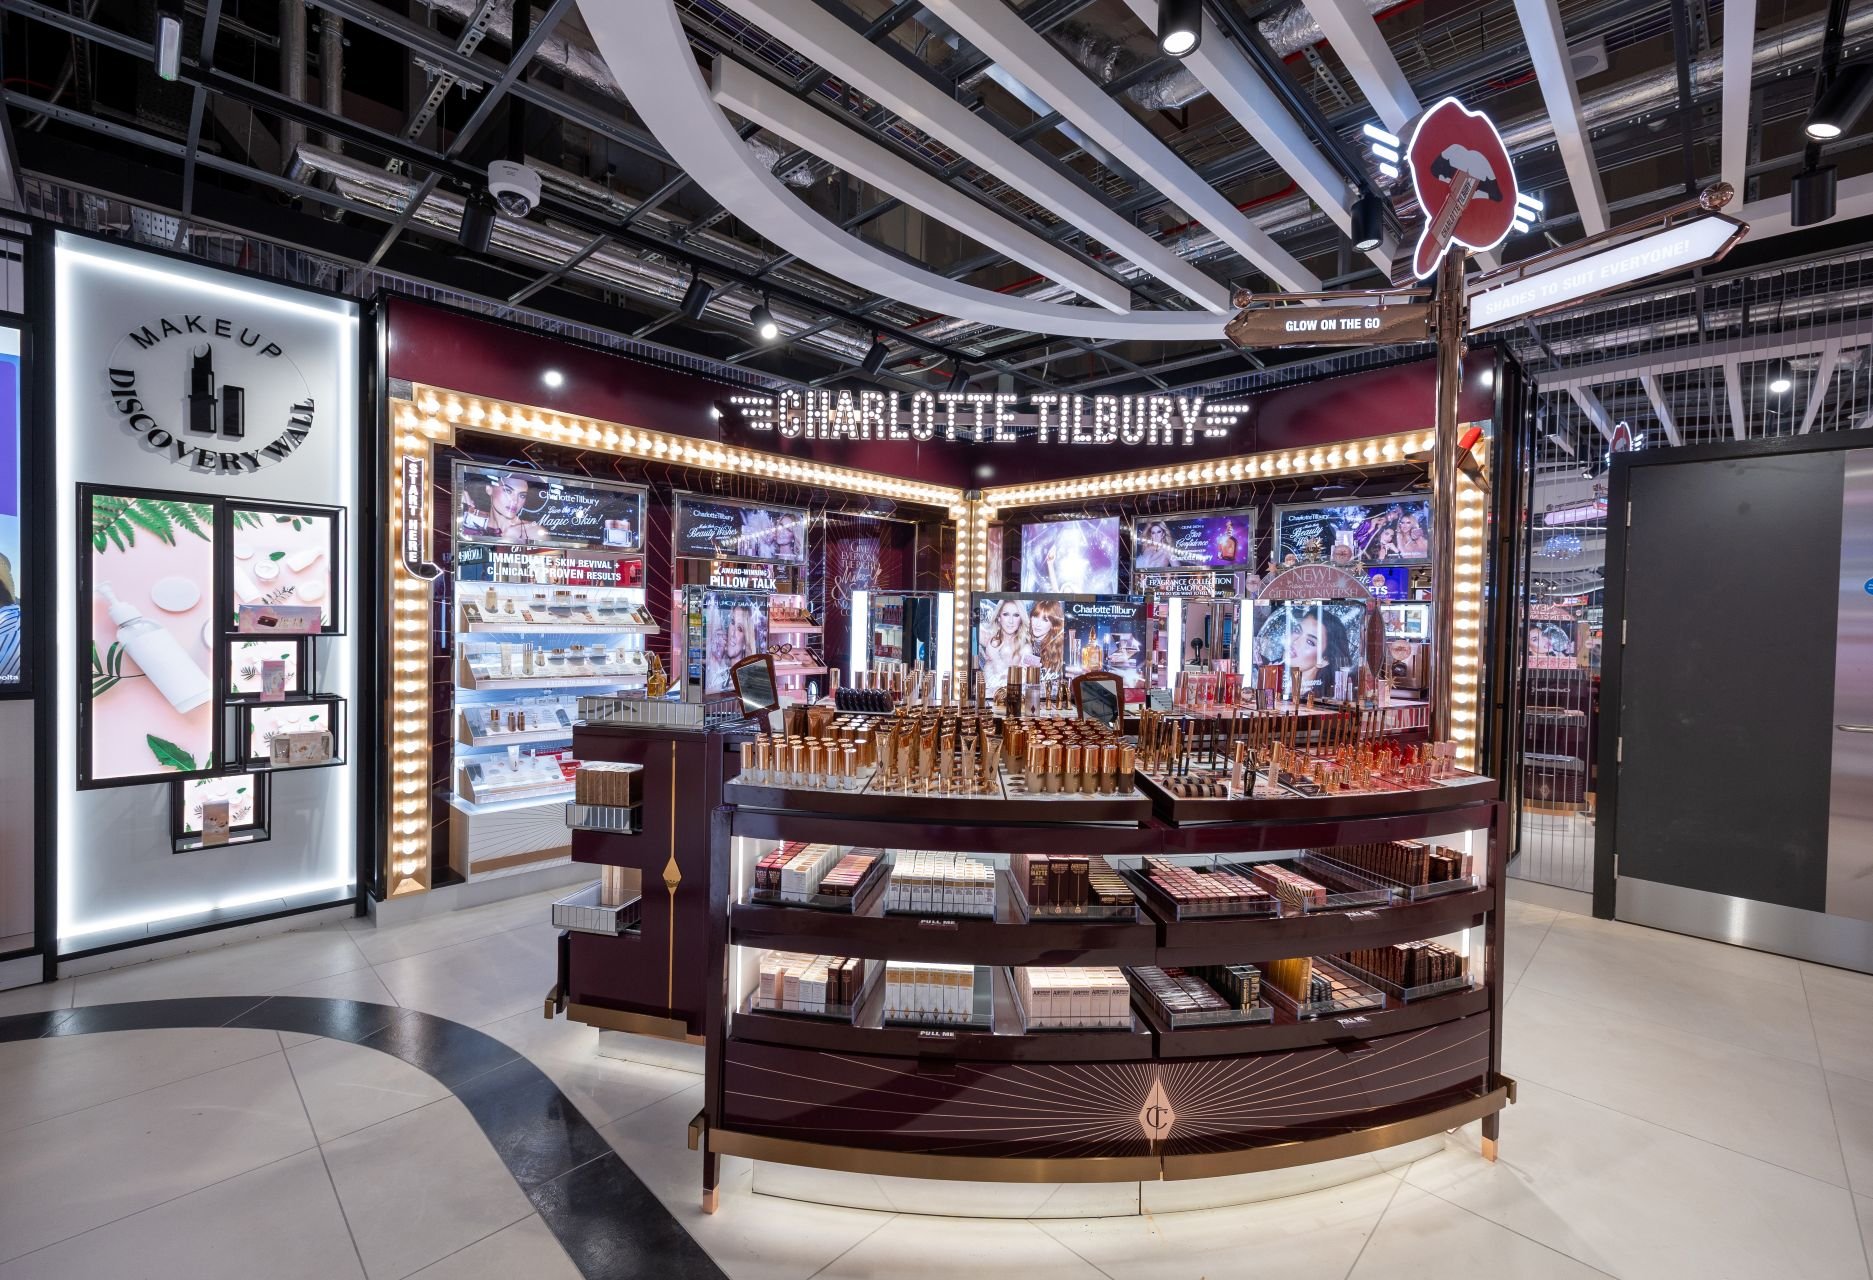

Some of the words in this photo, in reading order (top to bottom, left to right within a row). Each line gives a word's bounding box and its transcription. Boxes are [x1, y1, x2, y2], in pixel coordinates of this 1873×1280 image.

[1441, 203, 1461, 238] CHARLOTTE
[1485, 290, 1537, 315] SHADES
[1541, 284, 1559, 297] TO
[1563, 269, 1596, 290] SUIT
[1600, 239, 1690, 279] EVERYONE!
[1285, 320, 1317, 332] GLOW
[1320, 319, 1337, 331] ON
[1340, 318, 1362, 330] THE
[1364, 317, 1381, 329] GO
[129, 314, 283, 358] MAKEUP
[108, 367, 261, 470] DISCOVERY
[264, 397, 315, 458] WALL
[778, 389, 1017, 443] CHARLOTTE
[1030, 393, 1204, 446] TILBURY
[407, 462, 419, 516] START
[536, 513, 570, 531] Magic
[408, 519, 418, 563] HERE
[686, 526, 716, 541] Beauty
[489, 552, 553, 567] IMMEDIATE
[555, 557, 576, 567] SKIN
[578, 560, 612, 569] REVIVAL
[543, 567, 584, 580] PROVEN
[586, 571, 622, 581] RESULTS
[709, 575, 749, 588] PILLOW
[751, 577, 777, 589] TALK
[1149, 578, 1187, 587] FRAGRANCE
[1292, 567, 1332, 582] NEW!
[1268, 588, 1306, 599] GIFTING
